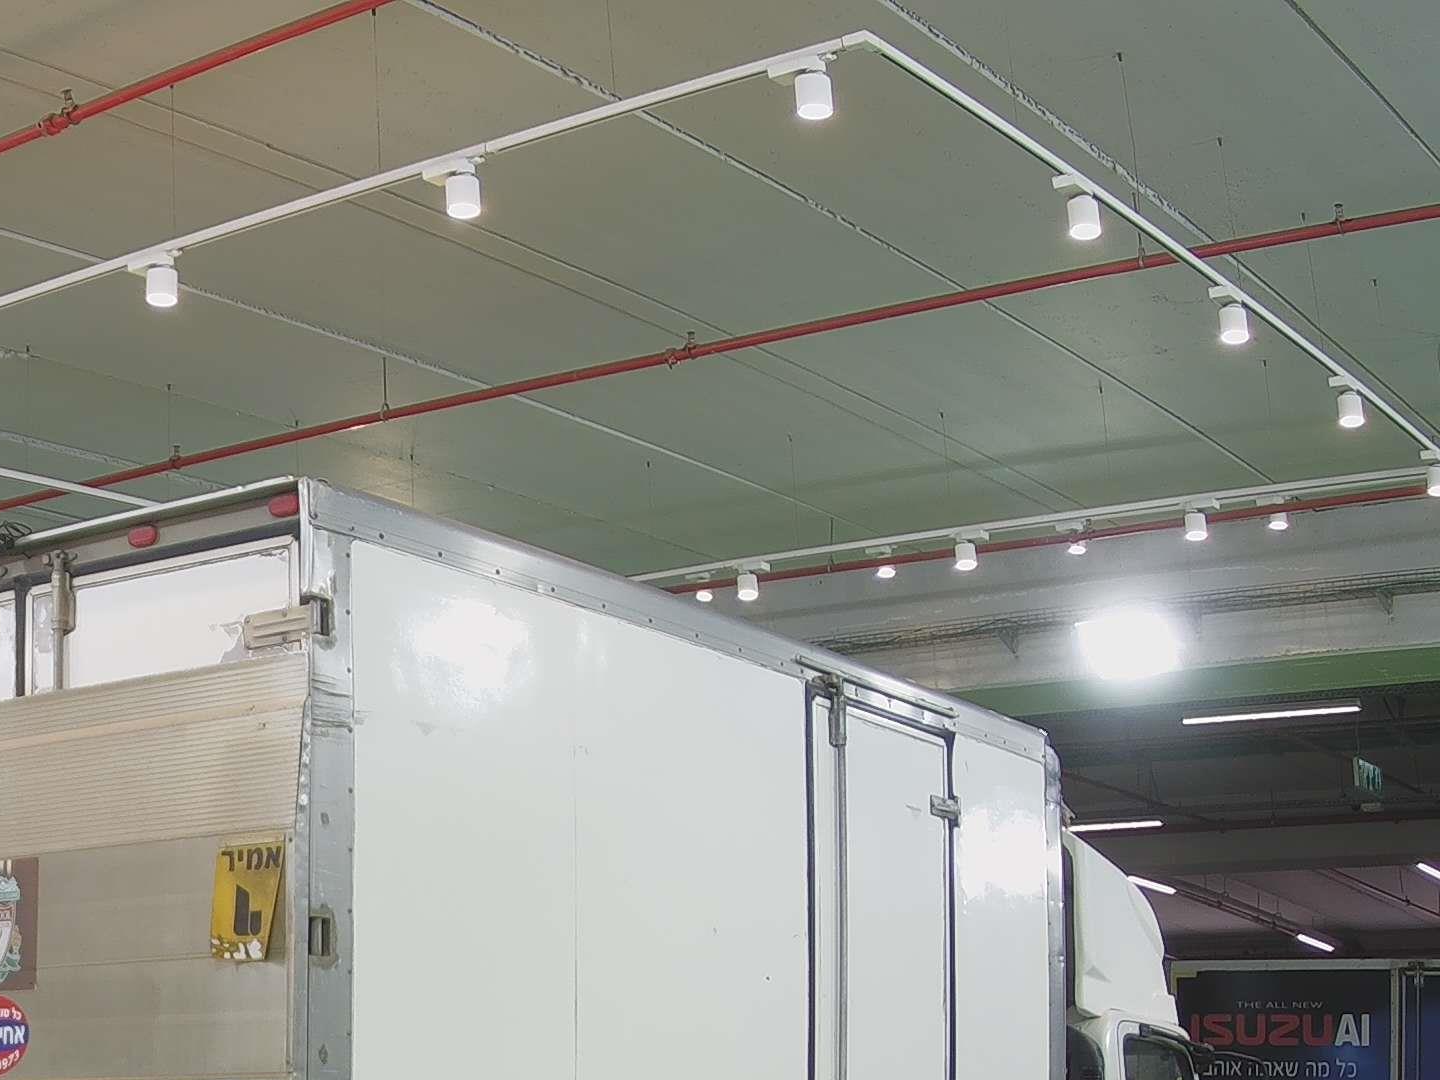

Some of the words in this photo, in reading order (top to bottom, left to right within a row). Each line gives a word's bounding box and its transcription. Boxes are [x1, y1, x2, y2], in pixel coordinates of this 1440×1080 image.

[221, 846, 282, 872] אמיר
[1236, 1000, 1260, 1009] THE
[1266, 1000, 1289, 1009] ALL
[1292, 1000, 1323, 1009] NEW
[1305, 1060, 1330, 1078] מה
[1336, 1057, 1358, 1078] כל
